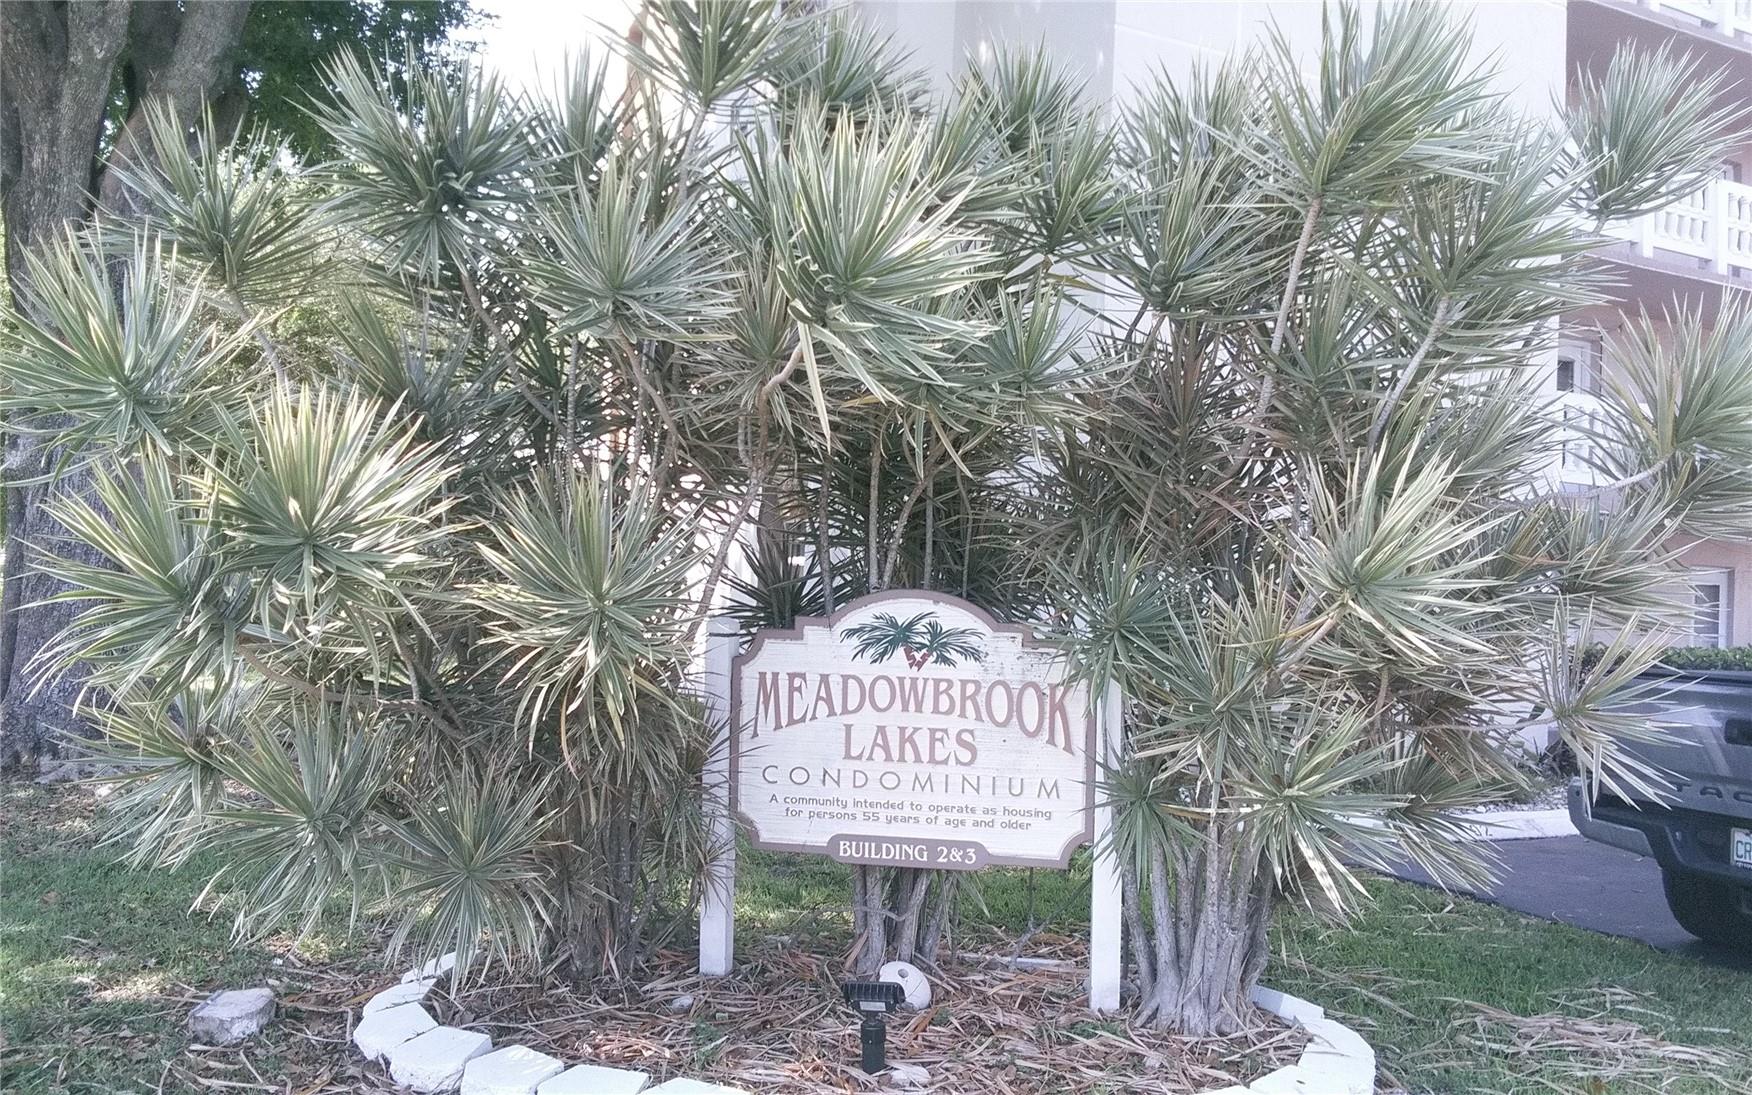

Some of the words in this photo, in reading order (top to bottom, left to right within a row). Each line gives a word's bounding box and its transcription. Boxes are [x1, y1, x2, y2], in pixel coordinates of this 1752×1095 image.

[750, 672, 1075, 756] MEADOWBROOK
[842, 723, 977, 766] LAKES
[762, 765, 1060, 799] CONDOMINIUM
[769, 793, 779, 804] A
[783, 795, 848, 809] community
[853, 797, 904, 810] intended
[910, 801, 922, 811] to
[928, 803, 976, 815] operate
[982, 807, 997, 816] as
[1002, 806, 1052, 820] housing
[785, 807, 803, 818] for
[808, 810, 857, 820] persons
[862, 811, 880, 821] 55
[885, 814, 920, 824] years
[925, 815, 939, 825] of
[944, 817, 966, 829] age
[972, 818, 994, 828] and
[1000, 820, 1032, 830] older
[839, 840, 928, 862] BUILDING
[936, 846, 976, 864] 2&3
